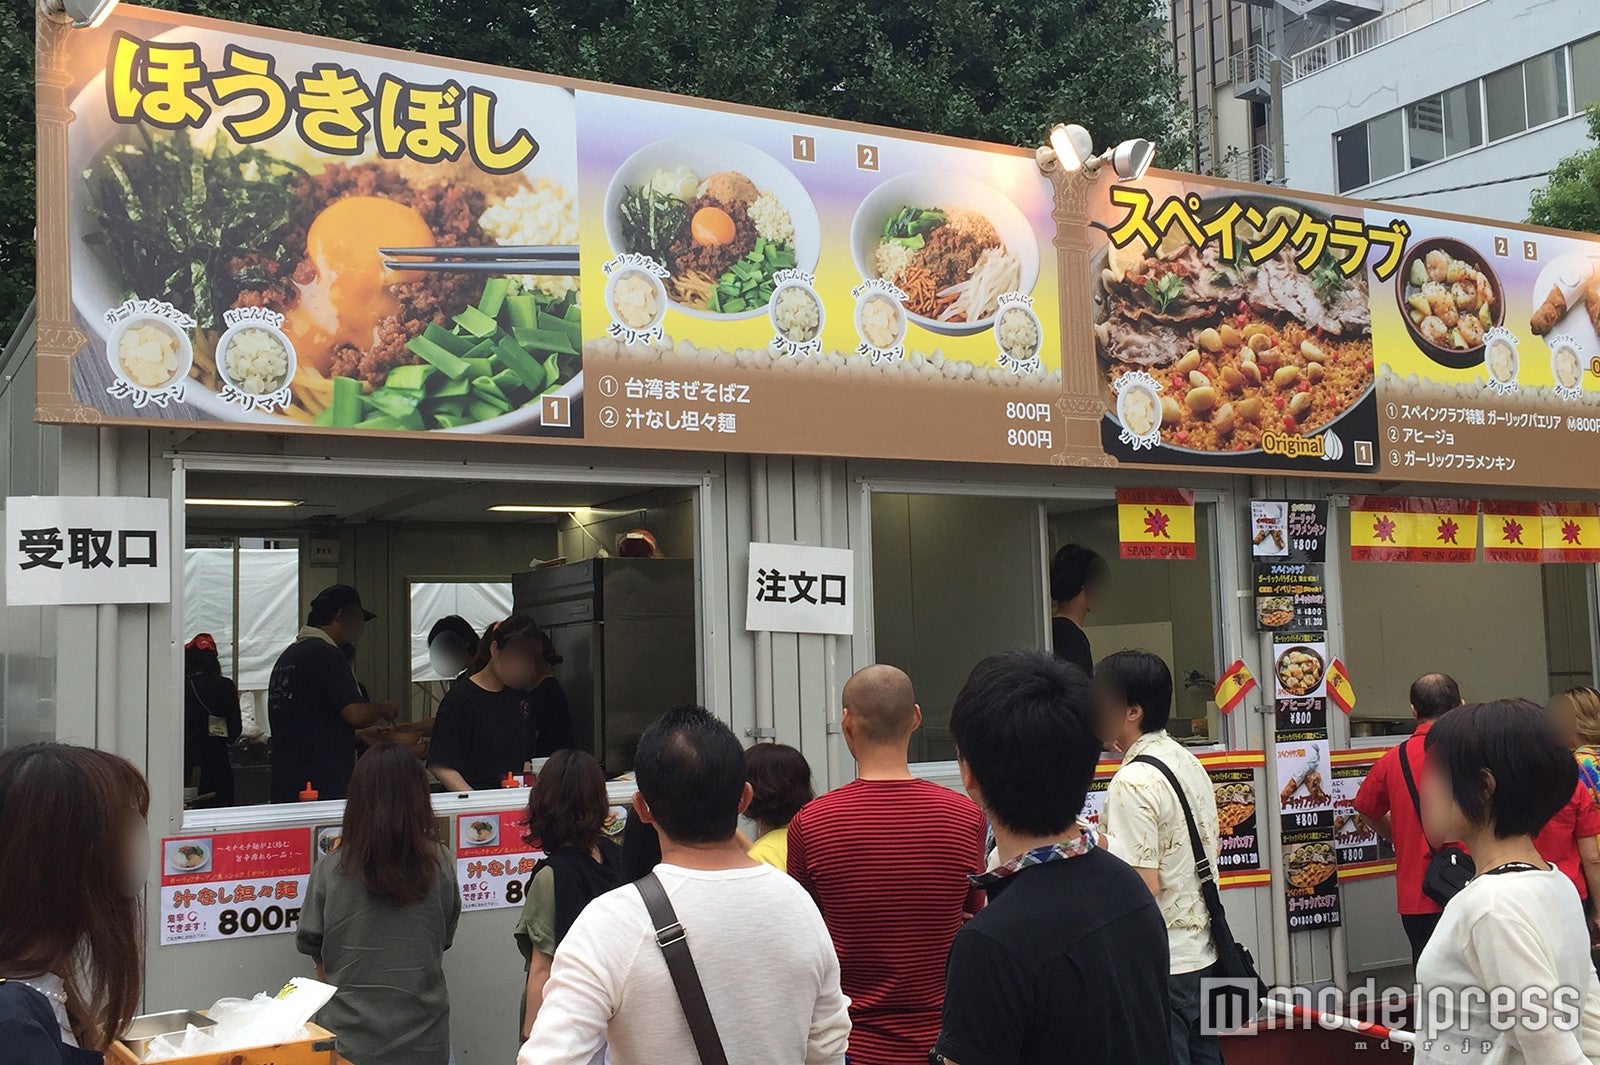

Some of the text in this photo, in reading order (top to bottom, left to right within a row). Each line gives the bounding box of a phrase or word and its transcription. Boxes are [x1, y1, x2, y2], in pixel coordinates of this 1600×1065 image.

[108, 32, 538, 172] ほうきぼし
[863, 148, 874, 166] 2
[1109, 185, 1410, 280] スペインクラブ
[105, 301, 194, 327] ガーリックチップ
[111, 381, 186, 406] ガリマシ
[624, 376, 751, 404] 台湾まぜそばZ
[1006, 401, 1051, 422] 800円
[1401, 404, 1485, 426] スペインクラブ特製
[1488, 410, 1562, 430] ガーリックパエリア
[1007, 428, 1052, 449] 800円
[1262, 431, 1324, 456] Original
[1402, 428, 1455, 446] アヒージョ
[1404, 451, 1516, 471] ガーリックフラメンキン
[19, 527, 158, 571] 受取口
[1127, 545, 1190, 557] SPAIN GARLIC
[1293, 539, 1318, 551] ¥800
[756, 568, 846, 606] 注文口
[1280, 697, 1322, 712] アヒージョ
[1290, 711, 1312, 724] ¥800
[1295, 812, 1319, 827] ¥800
[1342, 848, 1364, 861] ¥800
[467, 857, 536, 879] 汁なし担
